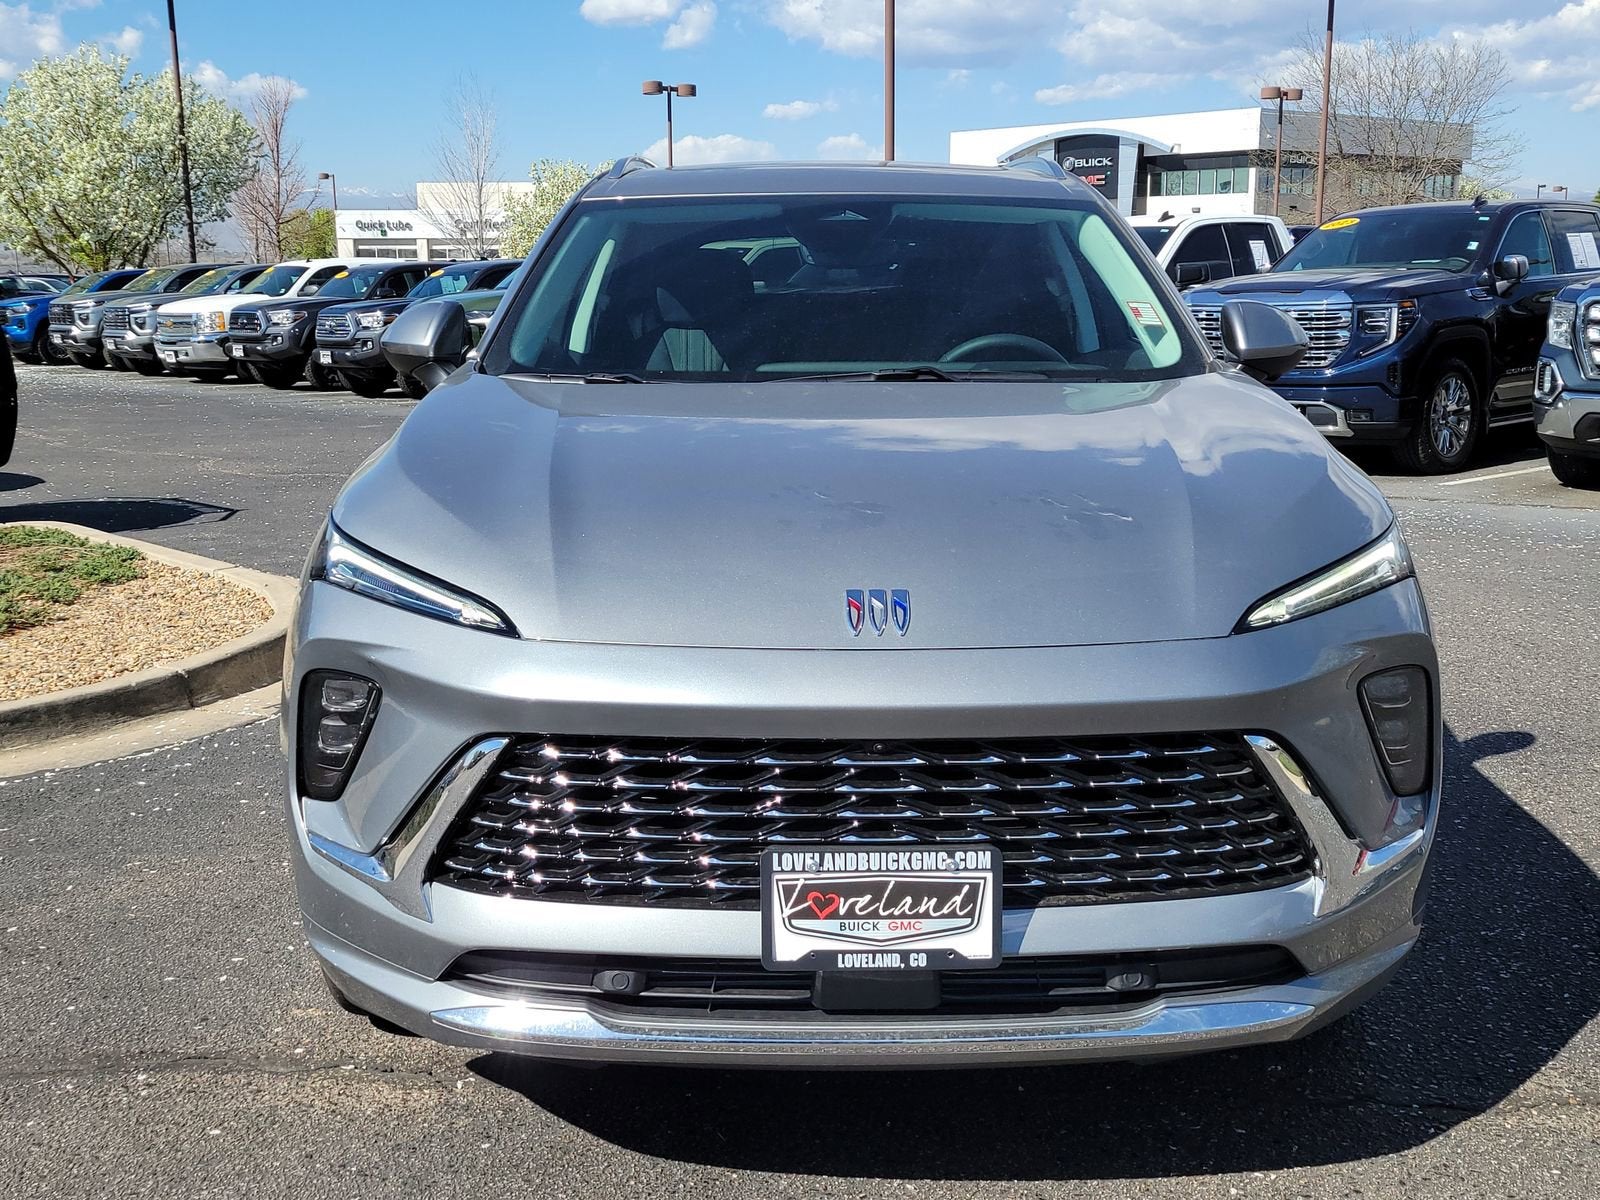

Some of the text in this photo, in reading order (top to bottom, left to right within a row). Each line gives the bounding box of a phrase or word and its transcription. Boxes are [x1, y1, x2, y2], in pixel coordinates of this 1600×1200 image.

[1075, 157, 1113, 167] BUICK
[1078, 175, 1106, 185] MC
[355, 219, 413, 232] Quick Lube
[454, 218, 509, 231] Certfied
[772, 851, 991, 871] LOVELANDBUICKGMCCOM
[839, 921, 923, 931] BUICK GMC
[837, 952, 927, 969] LOVELAND, CO
